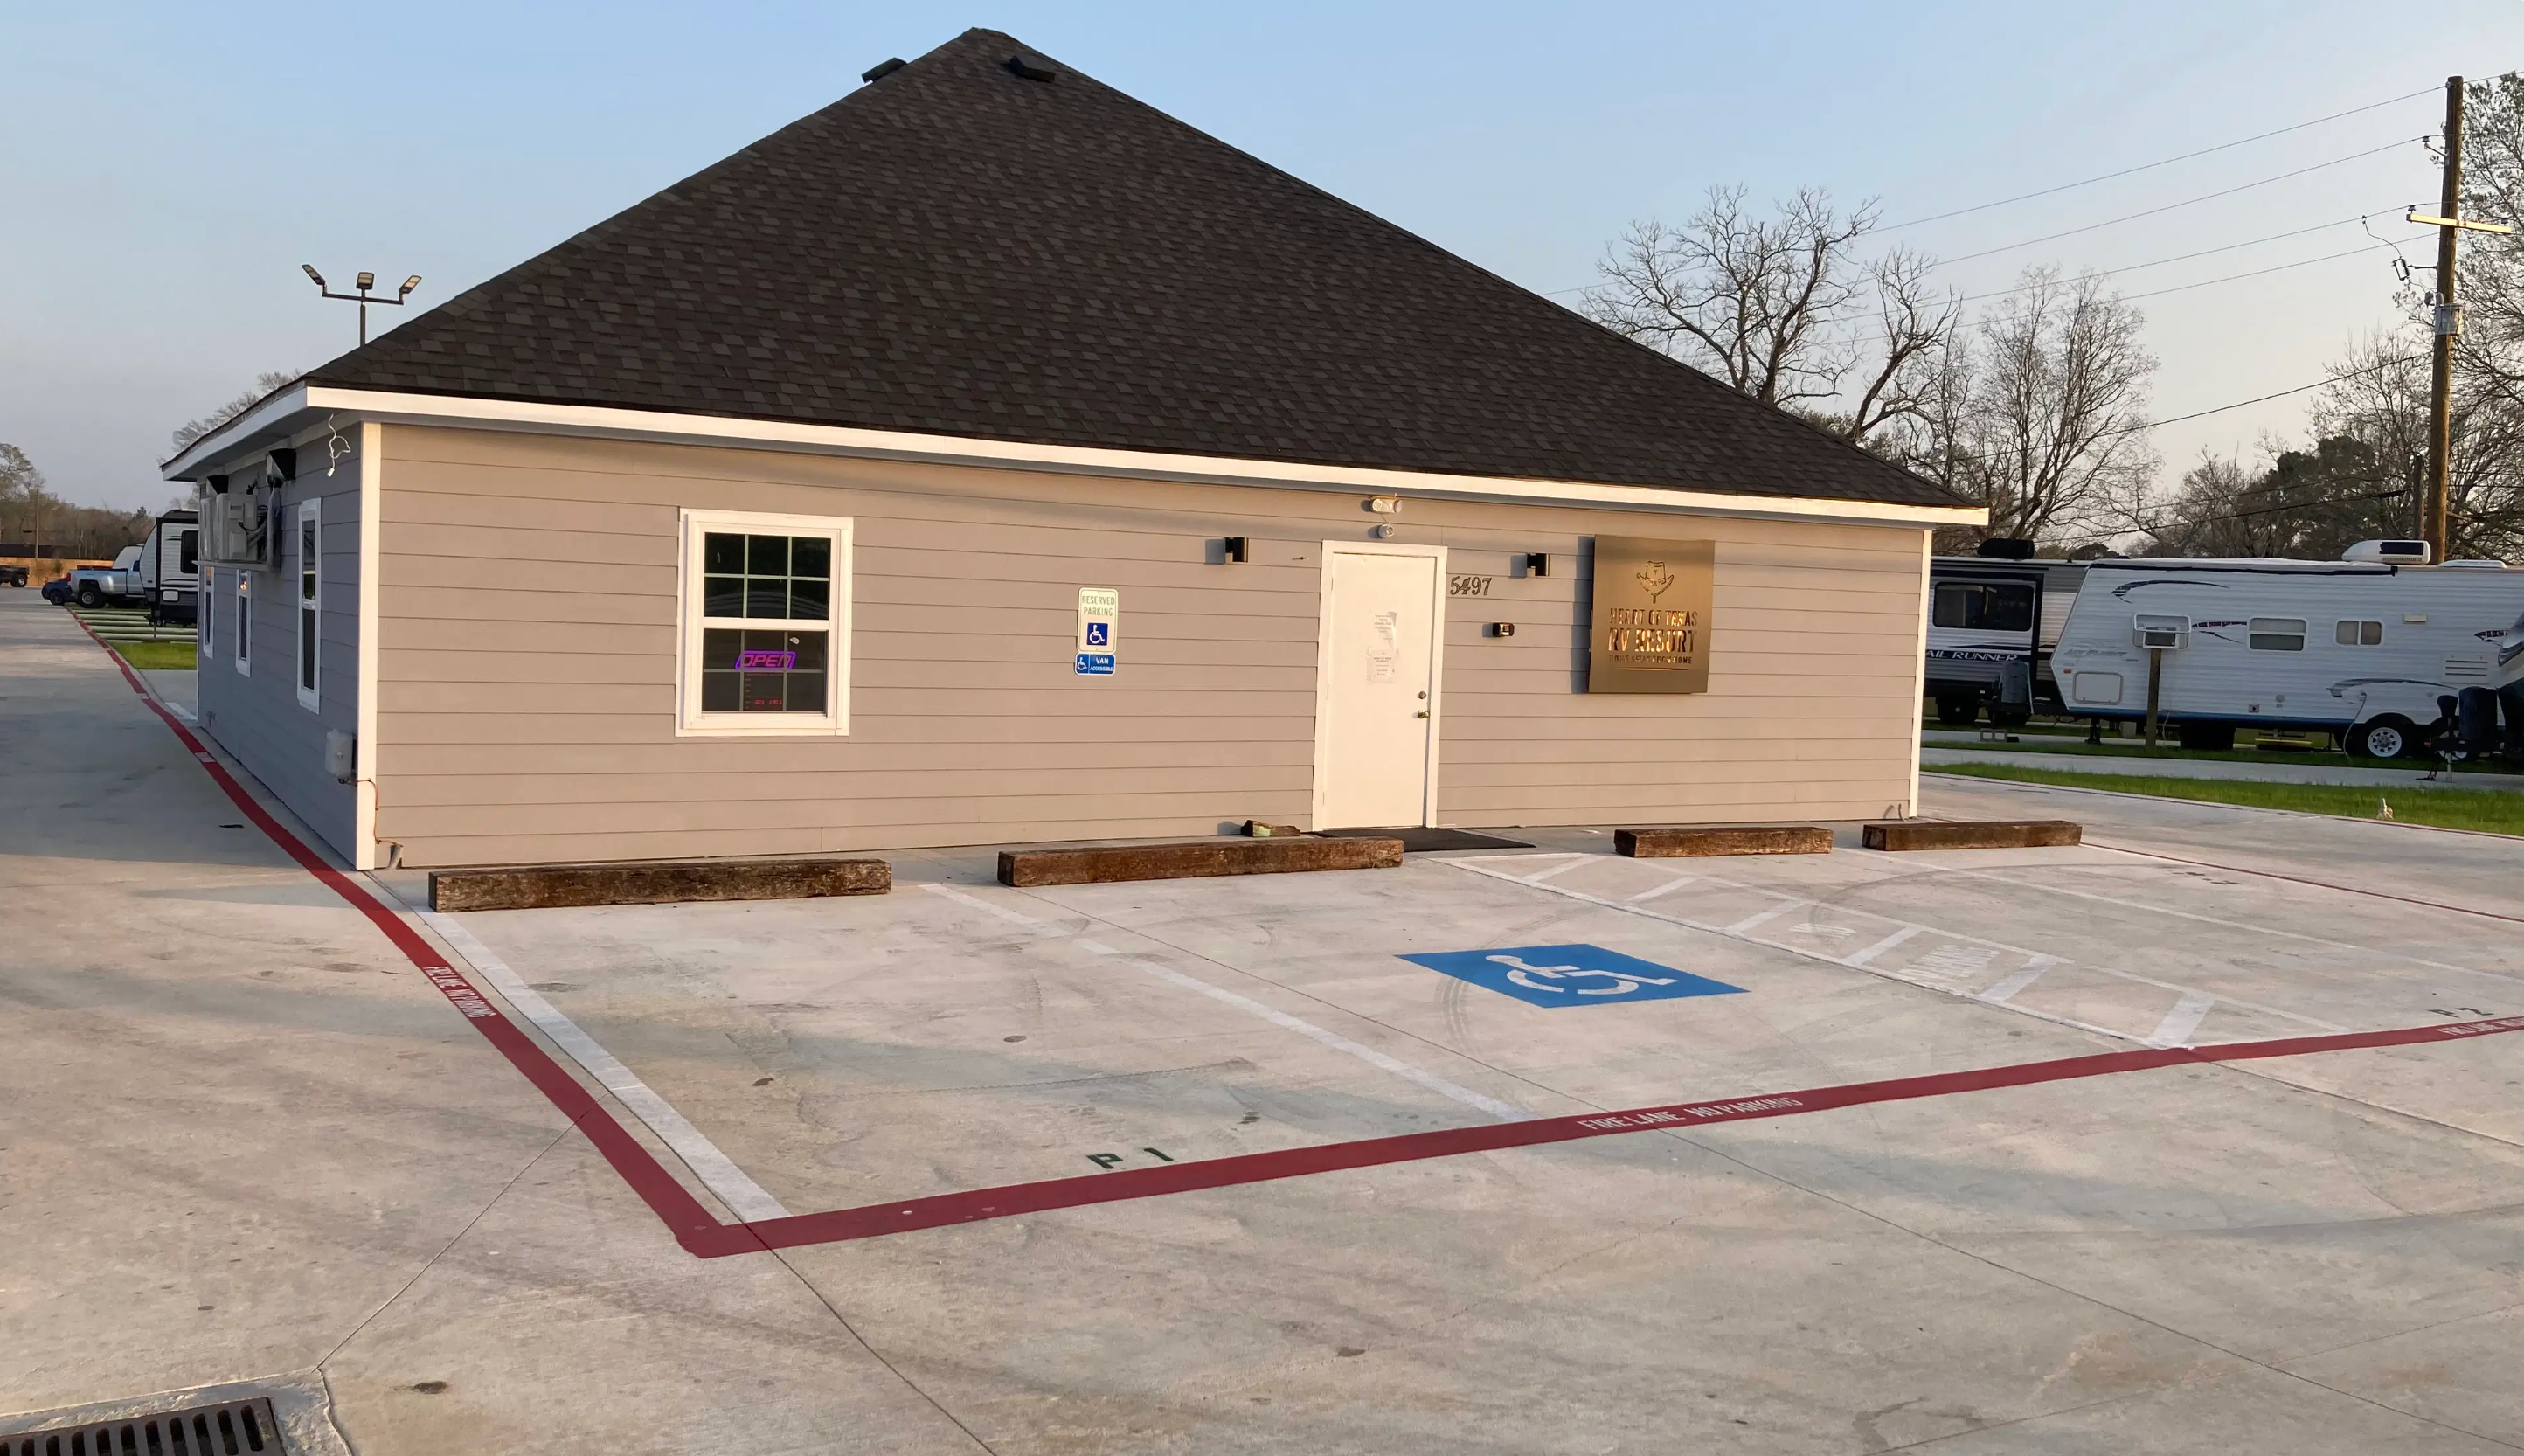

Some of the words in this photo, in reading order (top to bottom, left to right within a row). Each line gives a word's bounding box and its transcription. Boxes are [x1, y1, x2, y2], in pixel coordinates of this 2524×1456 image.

[1450, 576, 1492, 596] 5497
[1082, 595, 1115, 606] RESERVED
[1084, 607, 1113, 616] PARKING
[1610, 608, 1645, 625] HEART
[1648, 610, 1662, 626] OF
[1665, 610, 1698, 627] TEXAS
[1608, 627, 1632, 652] RV
[1633, 628, 1697, 653] RESORT
[742, 655, 793, 667] OPEN
[1952, 652, 2018, 662] RUNNER
[1577, 1116, 1633, 1130] FIRE
[1623, 1111, 1687, 1126] LANE
[1683, 1106, 1723, 1118] NO
[1719, 1097, 1803, 1114] PARKING
[1086, 1153, 1124, 1169] P
[1143, 1147, 1175, 1161] 1
